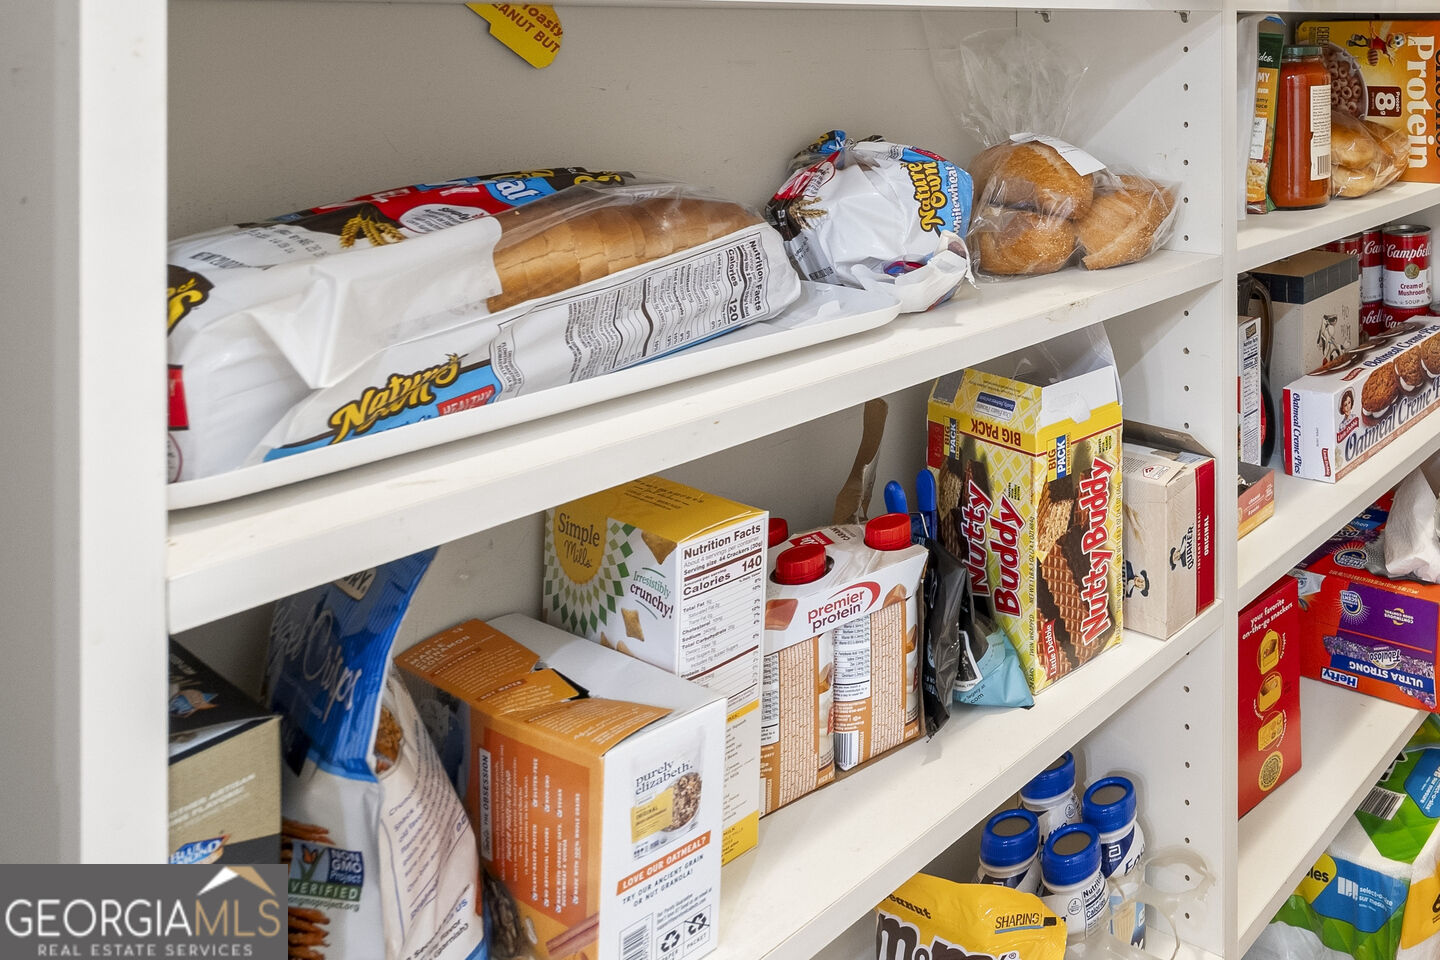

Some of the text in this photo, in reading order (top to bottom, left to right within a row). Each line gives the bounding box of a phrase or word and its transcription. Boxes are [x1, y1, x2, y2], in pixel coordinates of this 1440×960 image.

[1406, 35, 1435, 169] Protein
[728, 249, 739, 321] Calories 120
[750, 240, 764, 312] Nutrition Facts
[1398, 289, 1426, 297] Mushroom
[1363, 346, 1401, 368] Oatmeal
[1001, 429, 1021, 446] BIG
[1292, 392, 1302, 474] Oatmeal Creme Pies
[1344, 404, 1397, 462] Oatmeal
[1399, 390, 1431, 423] Creme
[1047, 439, 1067, 473] BIG PACK
[557, 512, 600, 548] Simple
[683, 524, 761, 560] Nutrition Facts
[960, 480, 994, 597] Nutty
[990, 493, 1025, 619] Buddy
[1080, 456, 1115, 646] Nutty Buddy
[1187, 525, 1195, 571] QUAKER
[633, 571, 671, 599] Irresistibly
[683, 555, 762, 596] Calories 140
[807, 590, 865, 624] premier
[812, 601, 862, 633] protein
[1250, 597, 1285, 629] your favorite
[1046, 624, 1054, 652] Debbie
[1242, 620, 1270, 640] on-the-go
[1322, 668, 1358, 688] Hefty
[1349, 661, 1424, 689] ULTRA STRONG
[966, 686, 981, 700] legacy
[635, 761, 674, 788] purely
[290, 881, 360, 901] VERIFIED
[622, 854, 704, 904] TRY ANCIENT GRAIN
[623, 861, 664, 889] LOVE OUR
